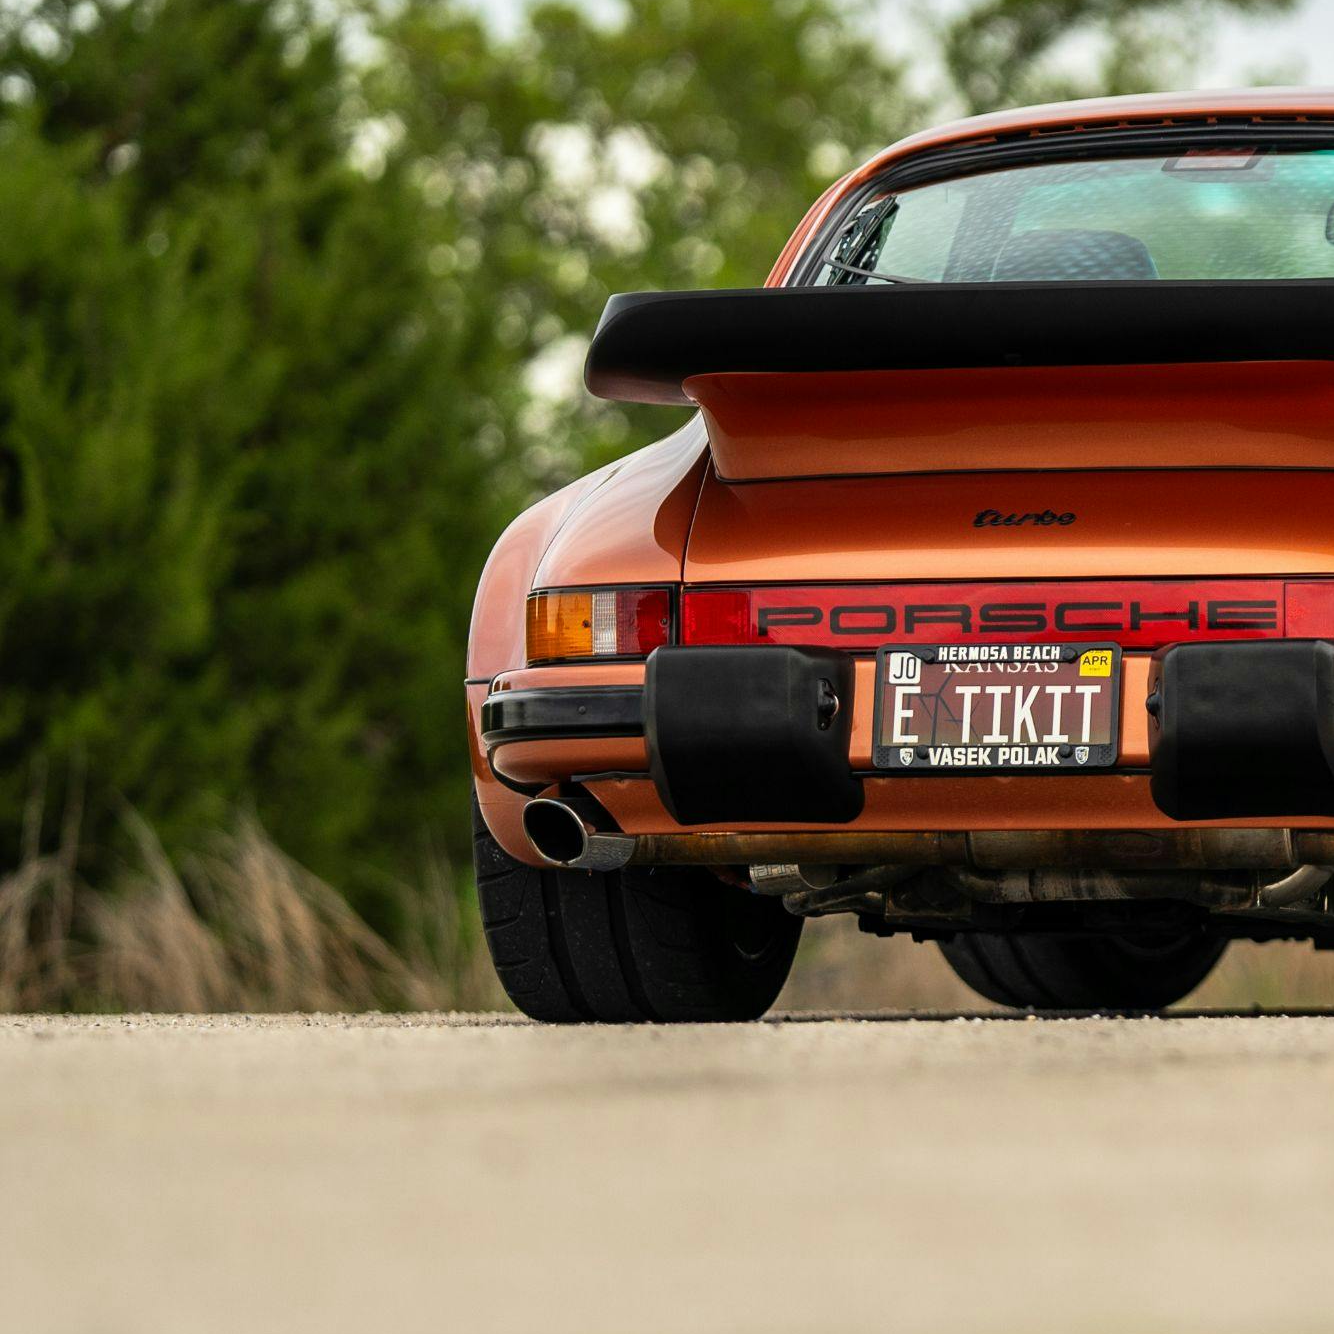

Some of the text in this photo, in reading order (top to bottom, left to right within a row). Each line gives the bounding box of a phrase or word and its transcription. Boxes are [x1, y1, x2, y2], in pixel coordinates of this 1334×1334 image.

[974, 509, 1076, 527] turbo
[757, 600, 1277, 635] PORSCHE
[938, 646, 1060, 661] HERMOSA BEACH
[1082, 655, 1108, 665] APR
[892, 685, 1101, 743] E TIKIT
[928, 746, 1060, 766] VASEK POLAK
